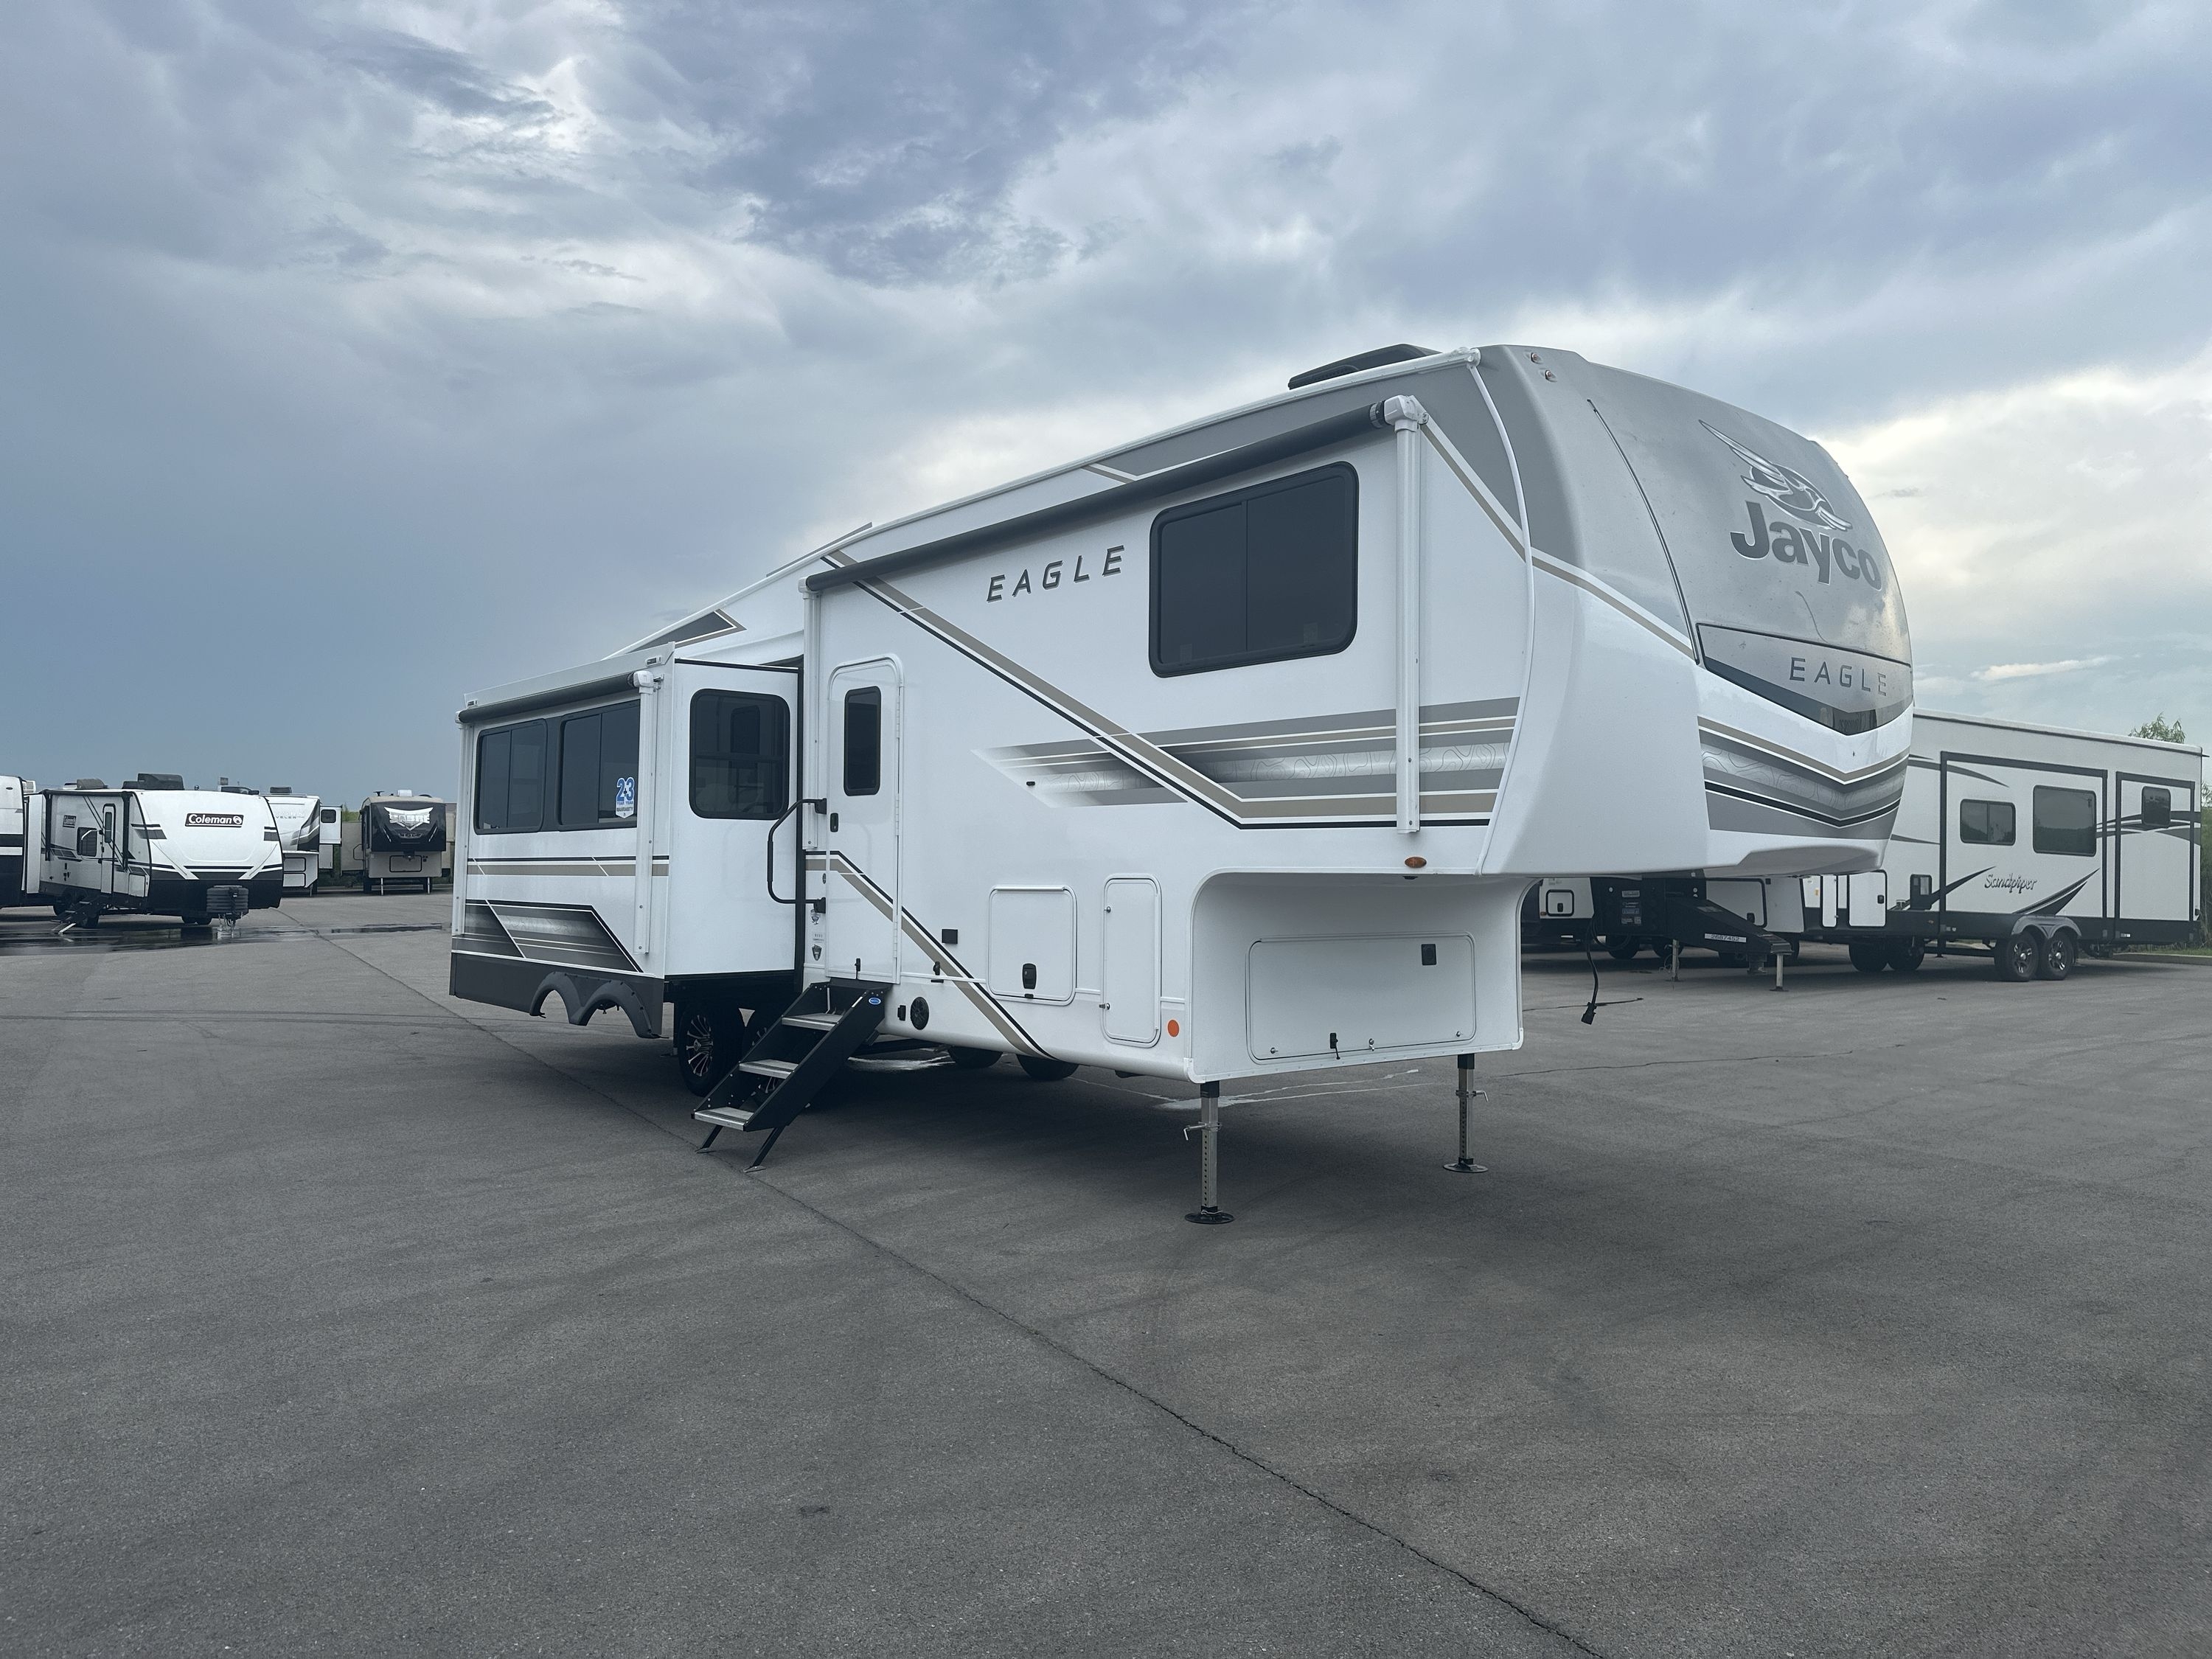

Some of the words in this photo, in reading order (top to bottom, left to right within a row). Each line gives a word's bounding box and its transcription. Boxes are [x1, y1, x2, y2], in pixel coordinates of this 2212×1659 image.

[1730, 500, 1882, 591] Jayco
[987, 545, 1124, 602] EAGLE
[1790, 657, 1887, 697] EAGLE
[188, 814, 232, 824] Coleman
[1984, 873, 2038, 894] Sandpiper
